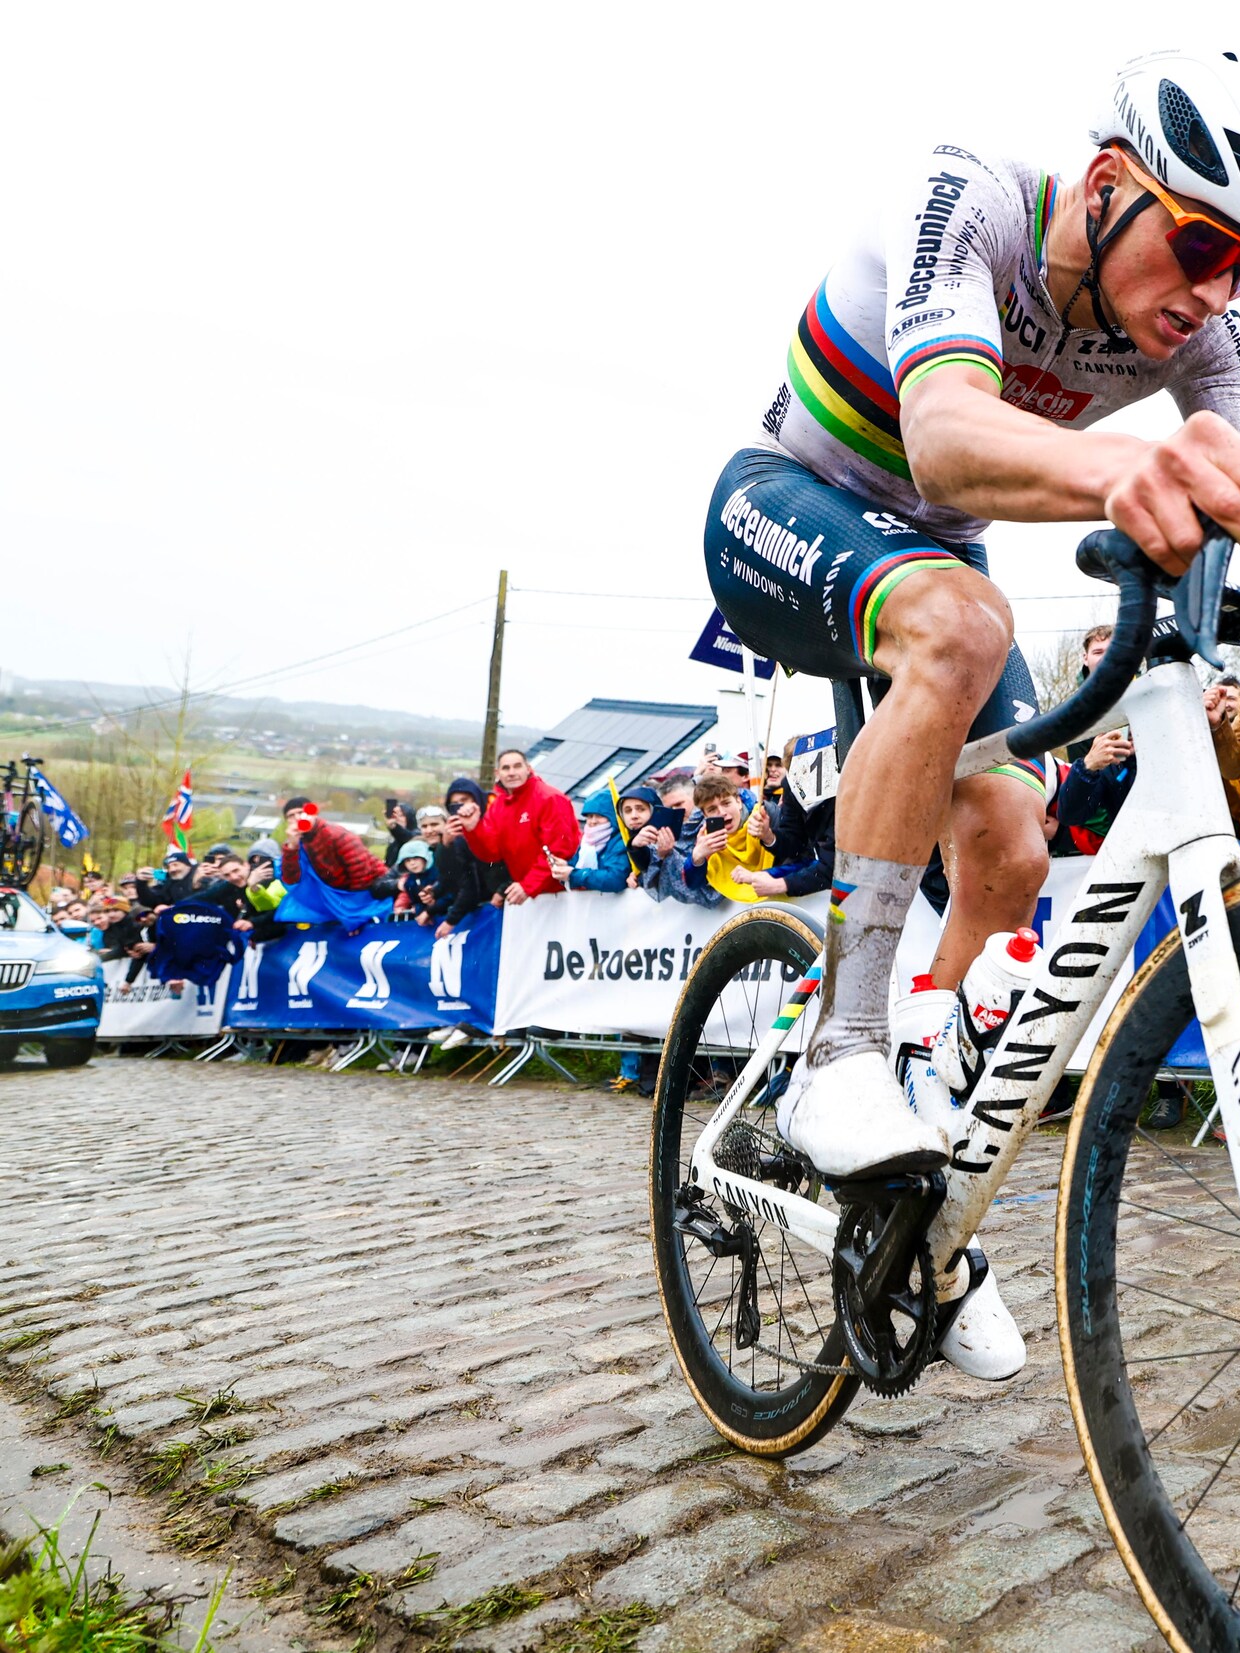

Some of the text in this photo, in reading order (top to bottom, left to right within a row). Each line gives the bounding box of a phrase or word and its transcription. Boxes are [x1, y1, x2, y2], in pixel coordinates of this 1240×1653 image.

[1114, 80, 1169, 185] CANYON
[895, 171, 969, 311] deceuninck
[891, 310, 944, 342] ABUS
[1004, 292, 1047, 355] UCI
[1073, 360, 1138, 377] CANYON
[762, 382, 789, 435] Alpecin
[1001, 371, 1075, 416] lpecin
[720, 482, 826, 587] deceuninck
[732, 557, 785, 603] WINDOWS
[544, 940, 585, 982] De
[588, 937, 675, 982] koers
[1188, 929, 1210, 949] ZWIFT
[949, 881, 1147, 1174] CANYON
[712, 1176, 791, 1231] CANYON
[753, 1378, 813, 1421] DURA-ACE
